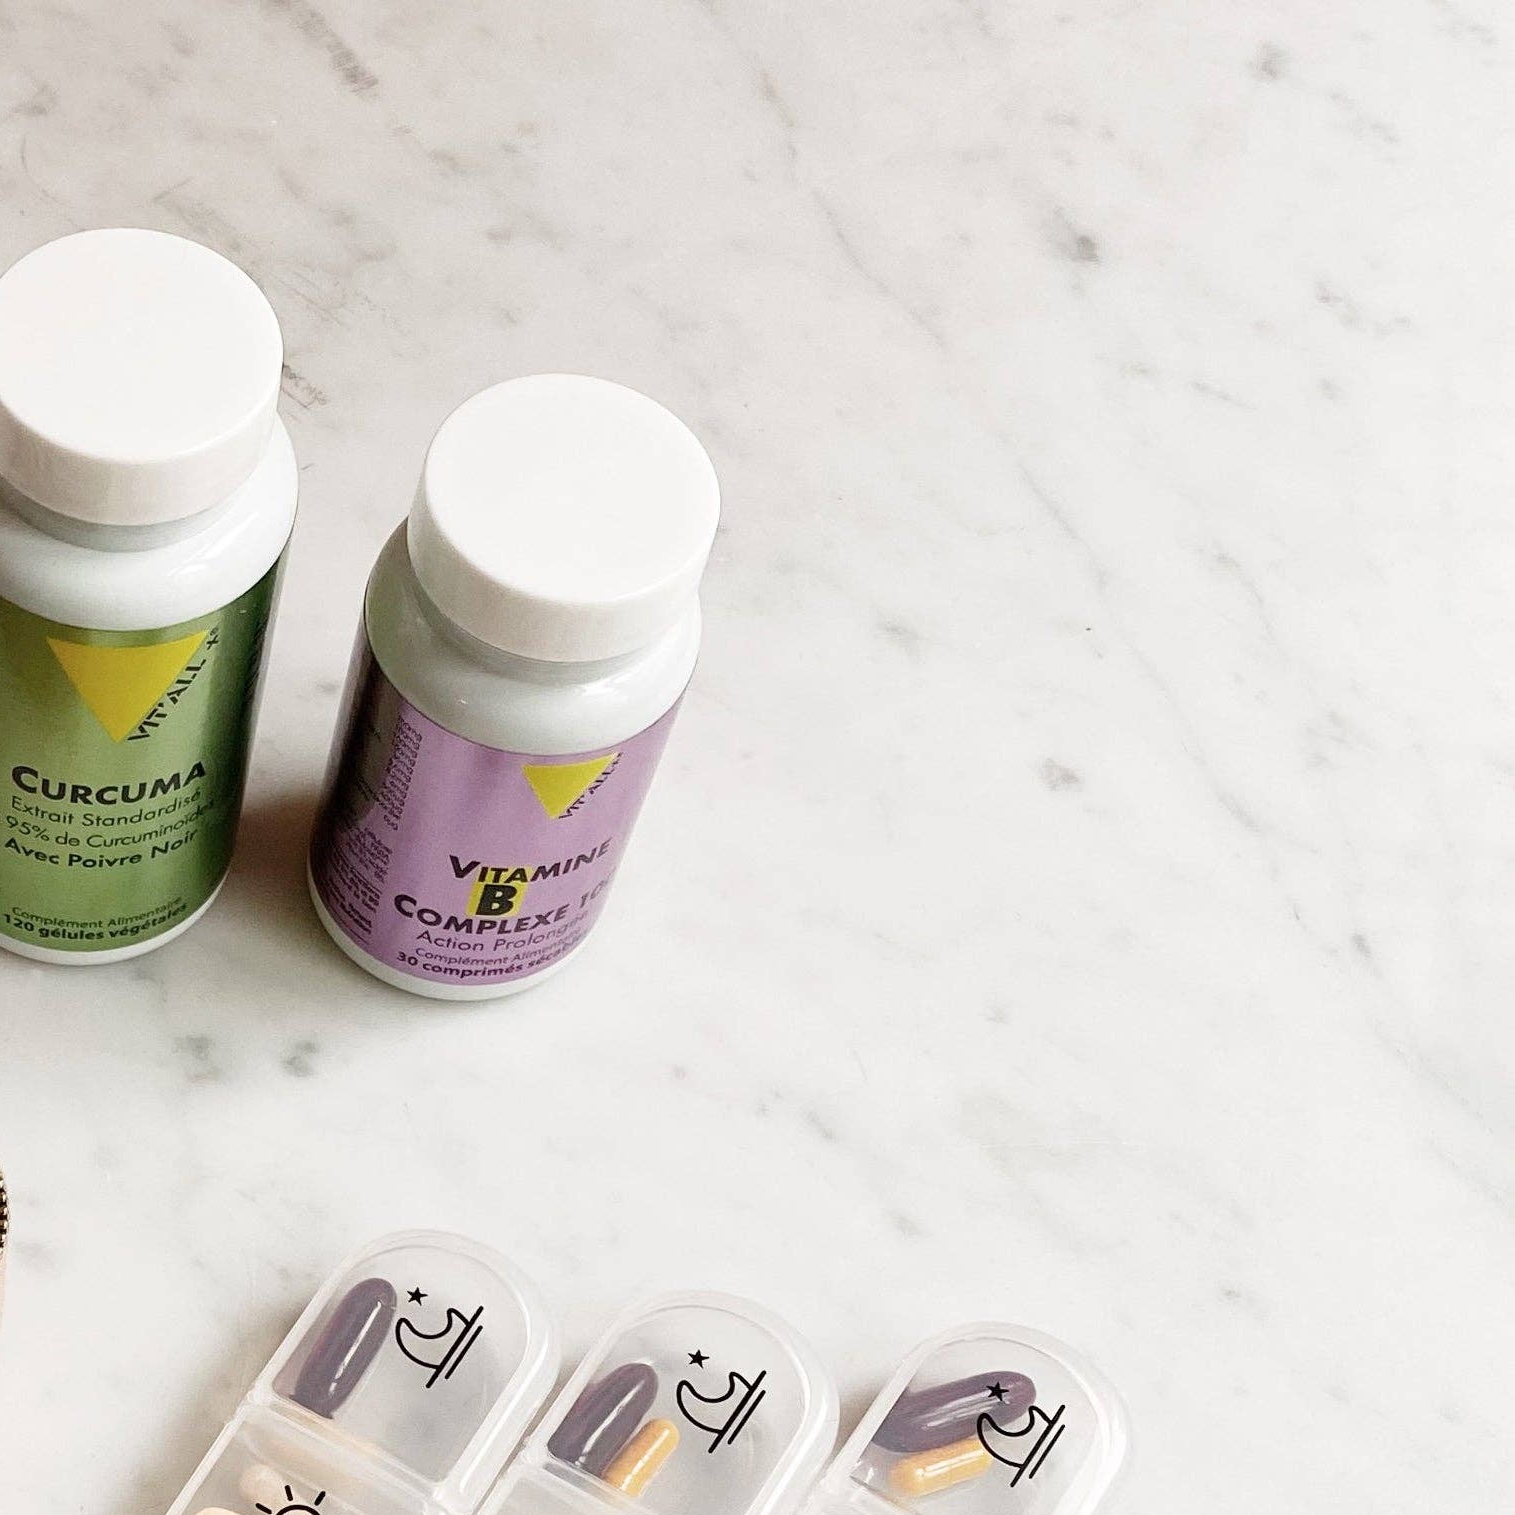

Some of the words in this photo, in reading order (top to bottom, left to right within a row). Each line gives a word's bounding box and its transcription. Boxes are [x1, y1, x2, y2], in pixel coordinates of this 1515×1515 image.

[11, 761, 206, 805] CURCUMA
[11, 795, 73, 826] Extrait
[82, 786, 201, 828] Standardisé
[6, 815, 50, 843] 95%
[55, 831, 80, 848] de
[4, 836, 60, 866] Avec
[68, 852, 142, 869] Poivre
[151, 829, 198, 860] Noir
[449, 837, 613, 885] VITAMINE
[394, 894, 570, 935] COMPLEXE
[475, 883, 516, 917] B
[3, 913, 34, 933] 120
[38, 925, 104, 941] gélules
[12, 906, 103, 930] Complément
[415, 947, 509, 967] Complément
[416, 929, 485, 952] Action
[397, 951, 419, 967] 30
[422, 962, 524, 980] comprimés
